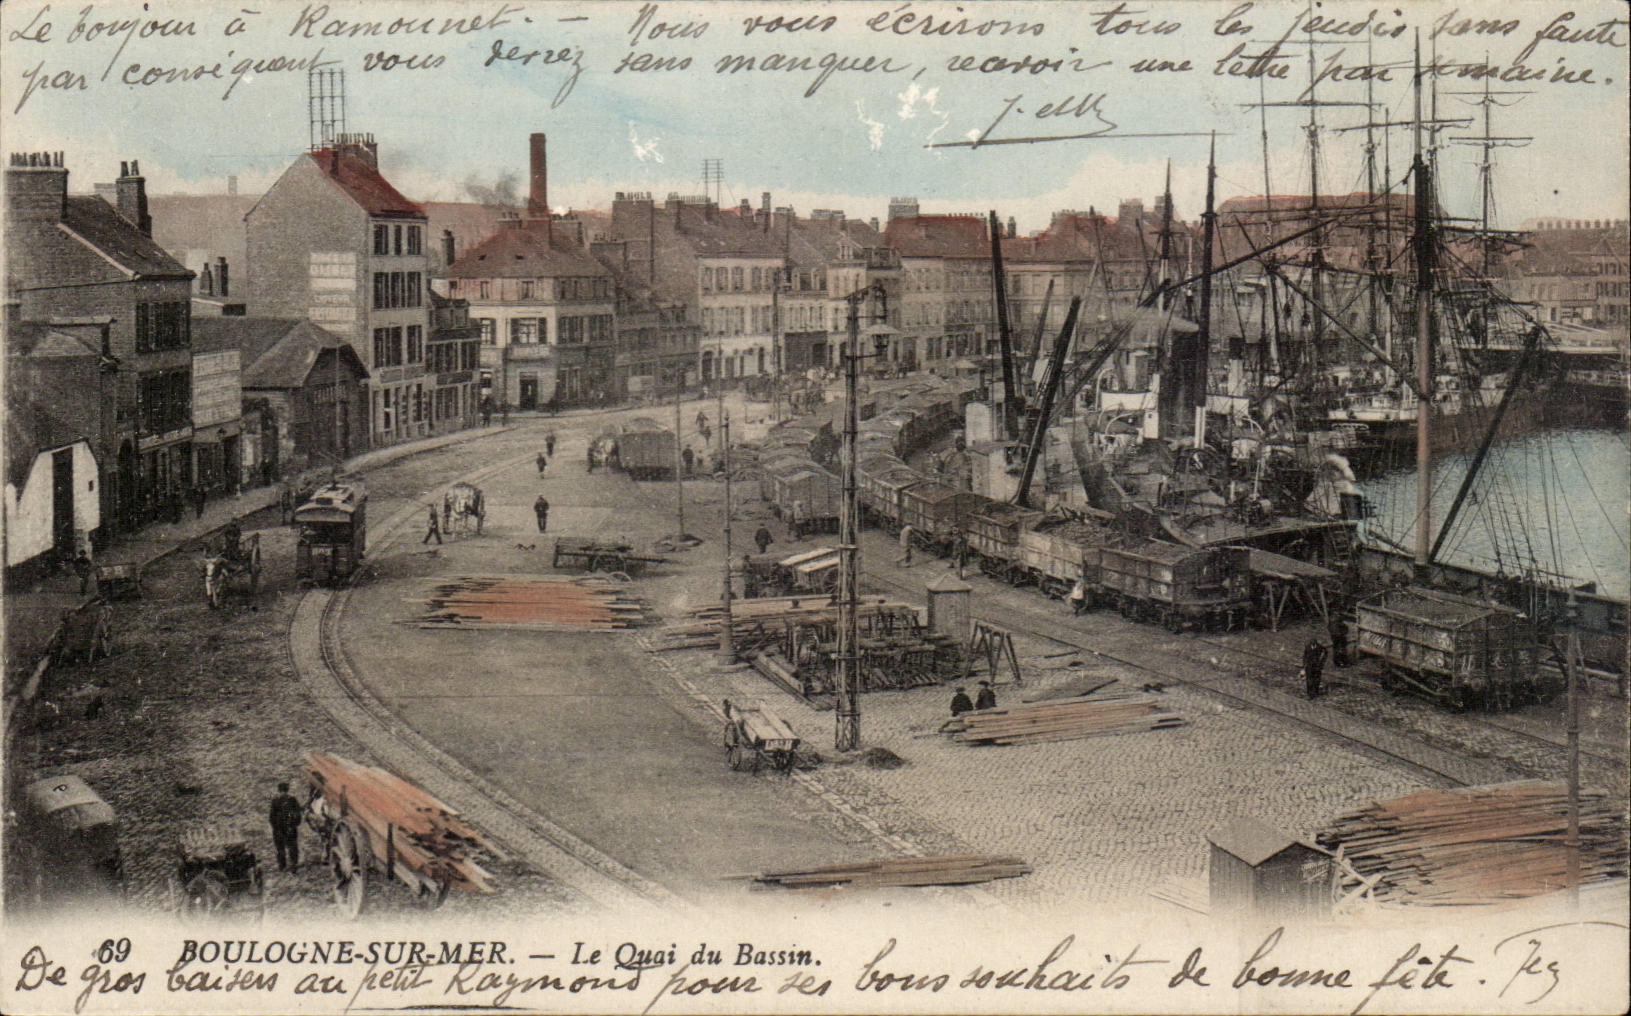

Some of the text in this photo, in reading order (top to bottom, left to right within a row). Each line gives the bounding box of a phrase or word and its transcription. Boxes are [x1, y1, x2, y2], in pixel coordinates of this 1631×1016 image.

[9, 4, 51, 42] Le
[66, 3, 196, 82] bonjour
[628, 3, 708, 47] Nous
[744, 16, 838, 37] vous
[866, 4, 1045, 36] écrirons
[1091, 4, 1183, 37] tous
[1214, 2, 1253, 36] les
[1257, 1, 1407, 68] jeudis
[1428, 8, 1520, 40] sans
[1512, 11, 1630, 66] faute
[14, 60, 89, 115] par
[121, 48, 344, 101] conséquent
[363, 50, 446, 72] vous
[613, 51, 694, 75] sans
[715, 53, 927, 98] manquer,
[1131, 56, 1195, 73] une
[1213, 42, 1303, 79] lettre
[1298, 48, 1394, 101] par
[15, 945, 68, 992] De
[75, 963, 146, 1014] gros
[167, 957, 280, 993] baisers
[294, 974, 349, 994] au
[342, 962, 434, 1014] petit
[444, 962, 662, 1008] Raymond
[641, 963, 764, 1015] pour
[777, 971, 832, 996] ses
[854, 938, 946, 993] bons
[959, 933, 1169, 993] souhaits
[1168, 947, 1210, 987] de
[1231, 926, 1352, 990] bonne
